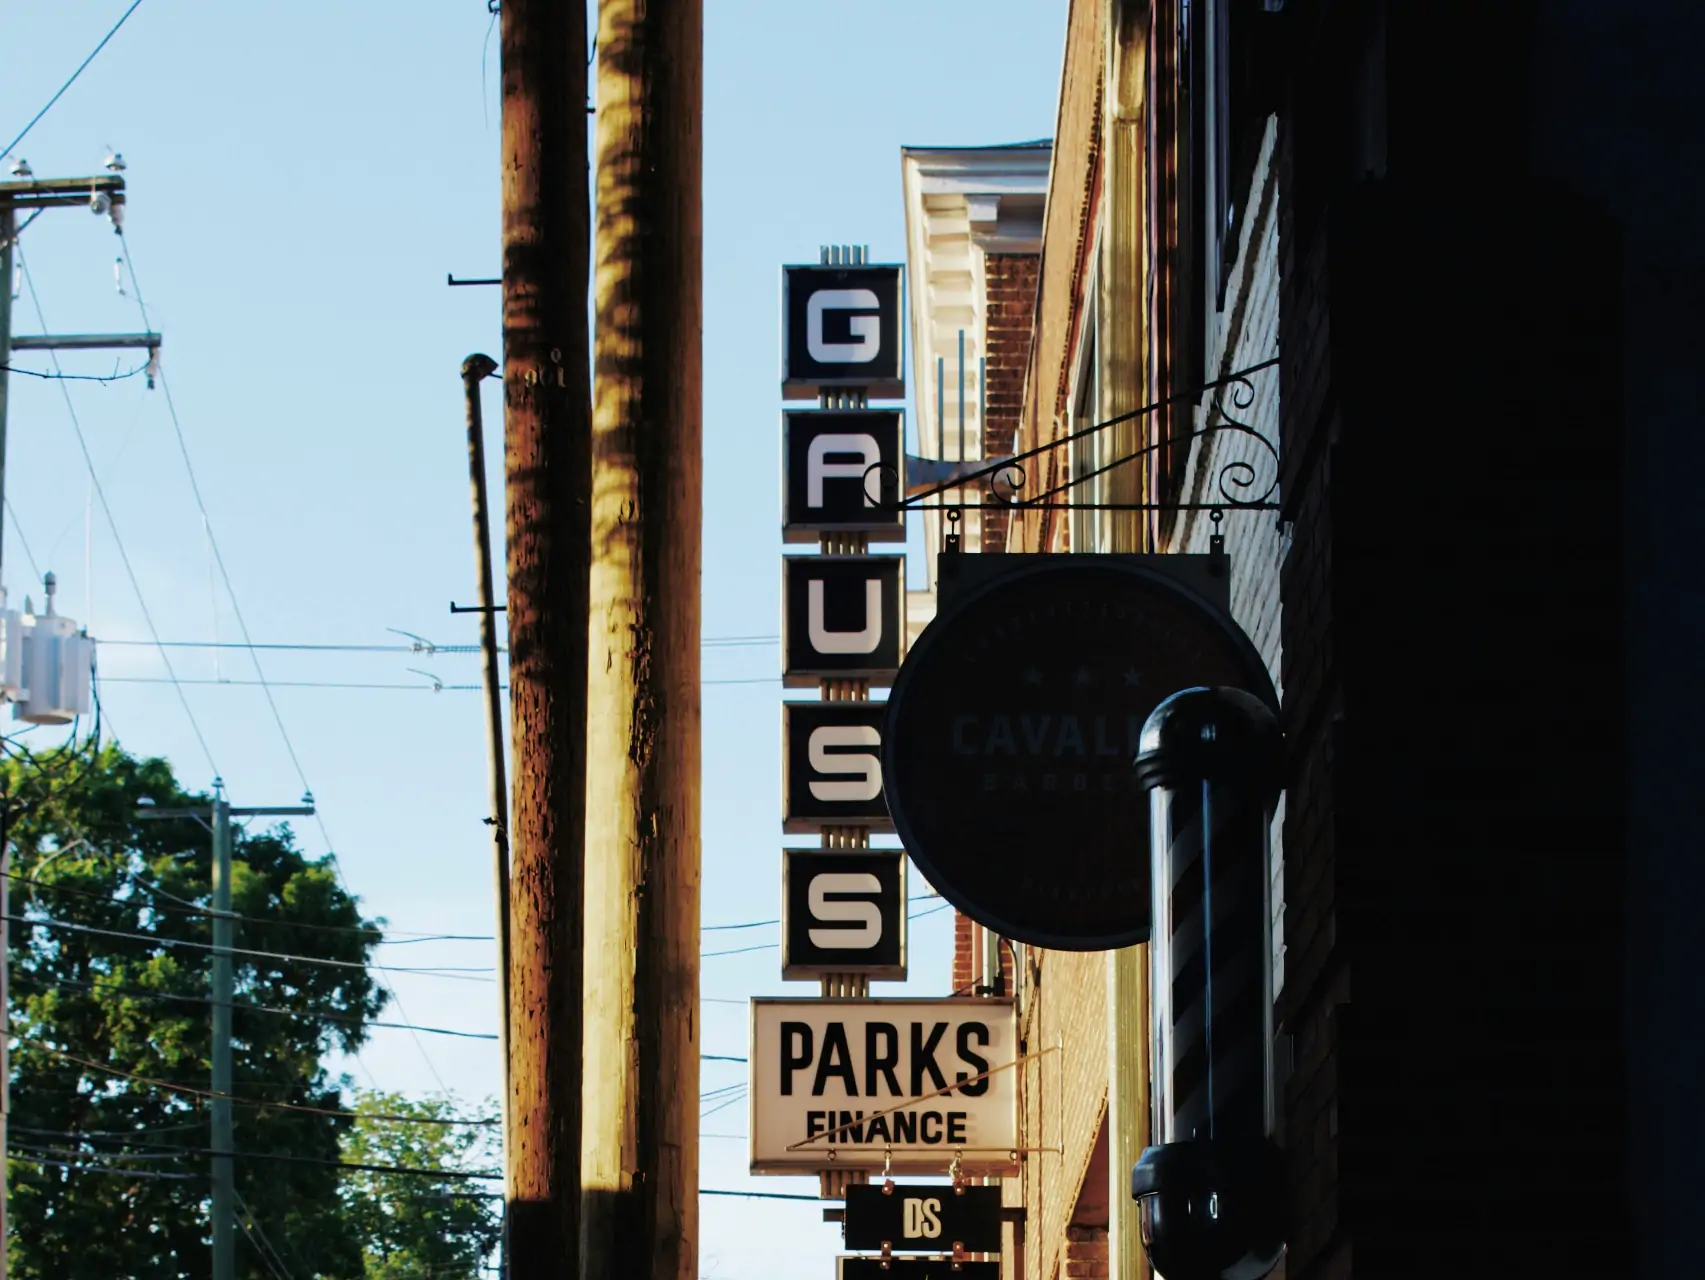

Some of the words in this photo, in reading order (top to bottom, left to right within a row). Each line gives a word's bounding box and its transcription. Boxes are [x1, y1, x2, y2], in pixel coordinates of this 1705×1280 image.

[806, 288, 882, 949] GAUSS
[780, 1021, 990, 1097] PARKS
[806, 1110, 967, 1144] FINANCE
[902, 1197, 942, 1239] DS
